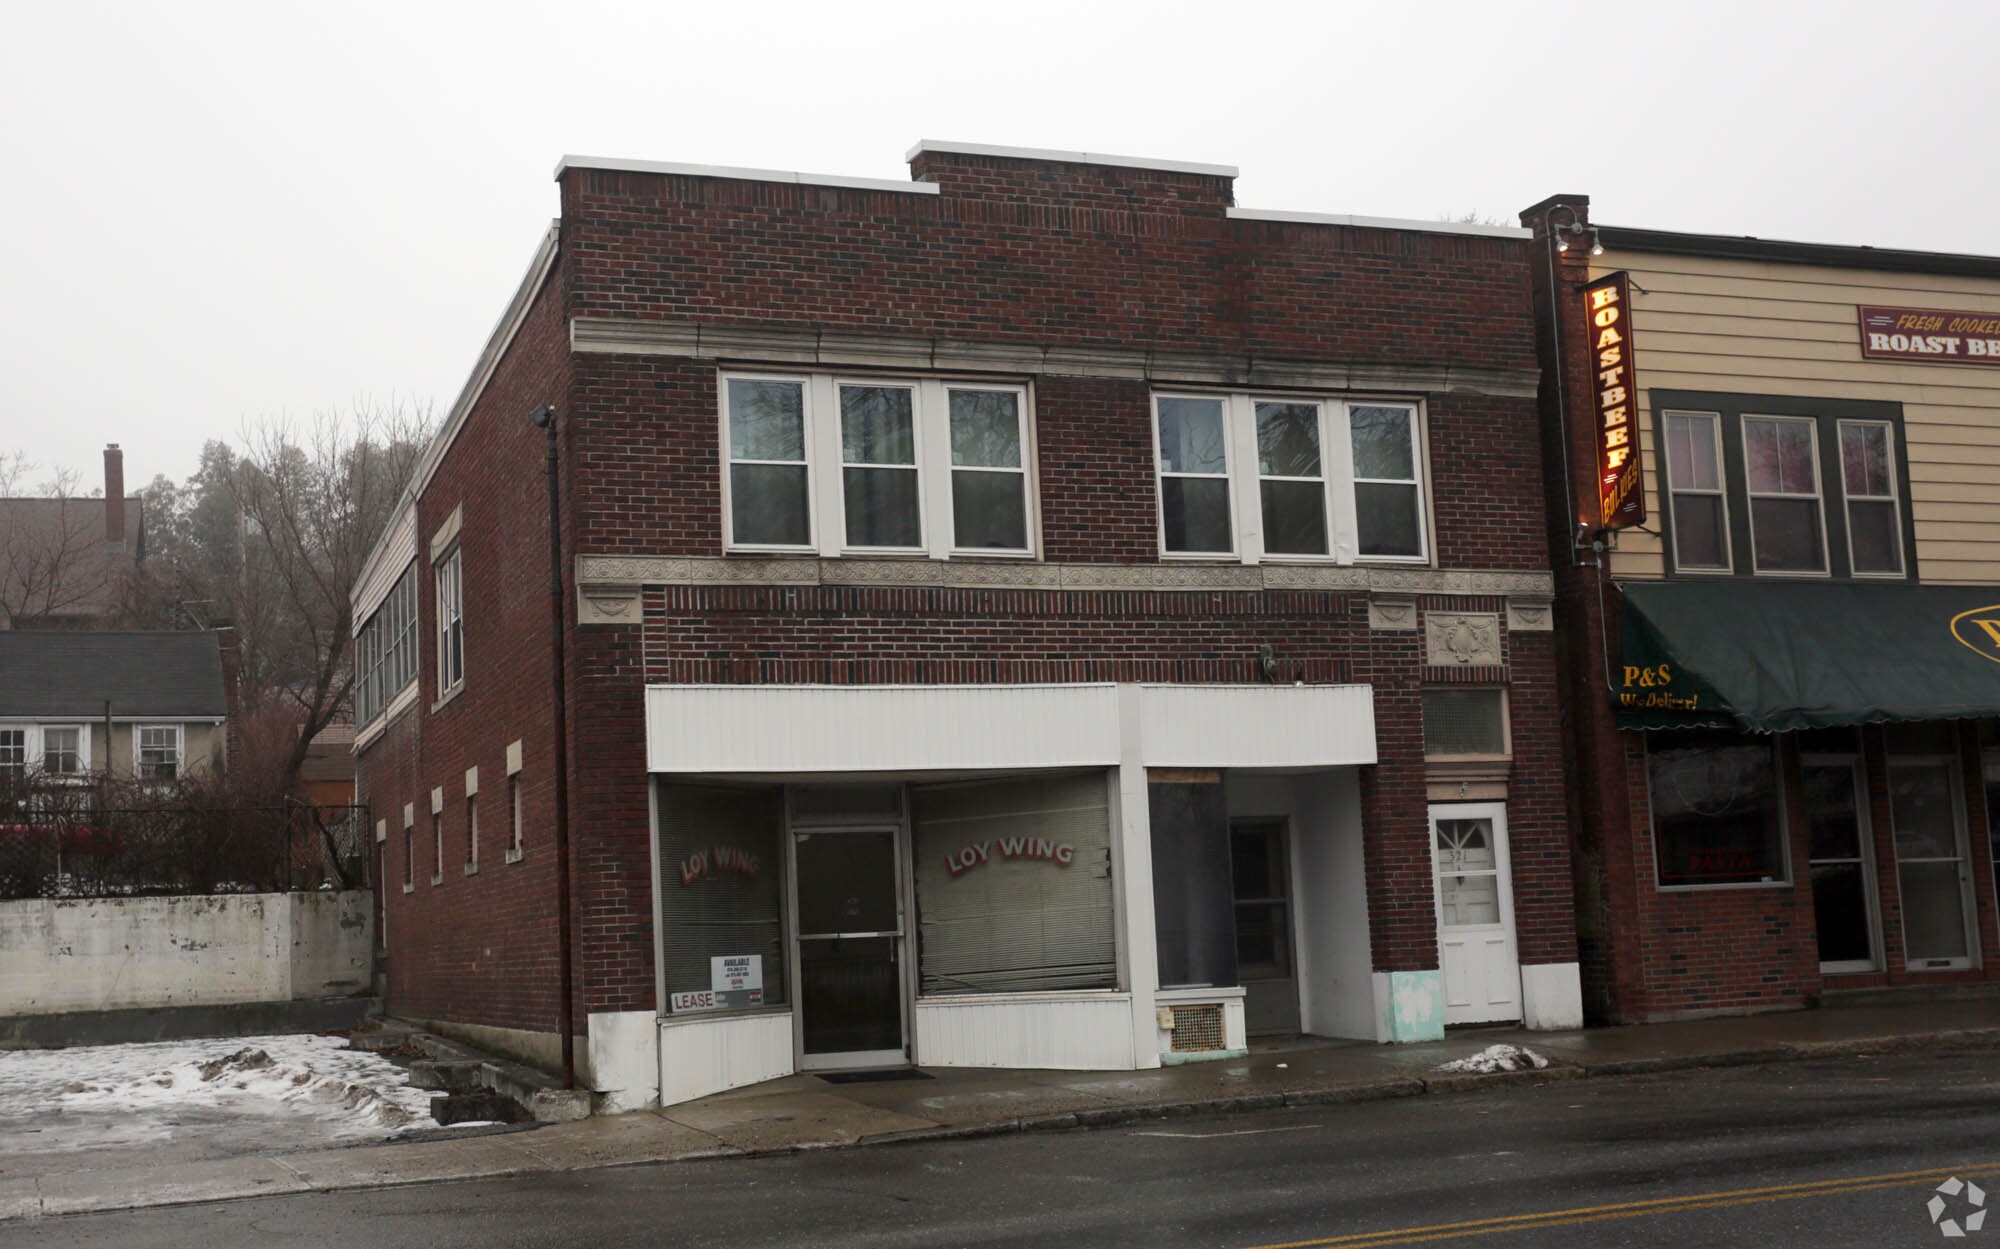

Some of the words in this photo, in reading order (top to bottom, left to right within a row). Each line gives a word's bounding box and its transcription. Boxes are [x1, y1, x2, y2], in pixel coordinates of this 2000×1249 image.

[1895, 313, 1945, 332] FRESH
[1868, 332, 1961, 354] ROAST
[1623, 663, 1672, 687] P&S
[680, 848, 709, 886] LOY
[713, 845, 760, 878] WING
[945, 838, 990, 876] LOY
[997, 836, 1075, 866] WING
[674, 992, 713, 1010] LEASE
